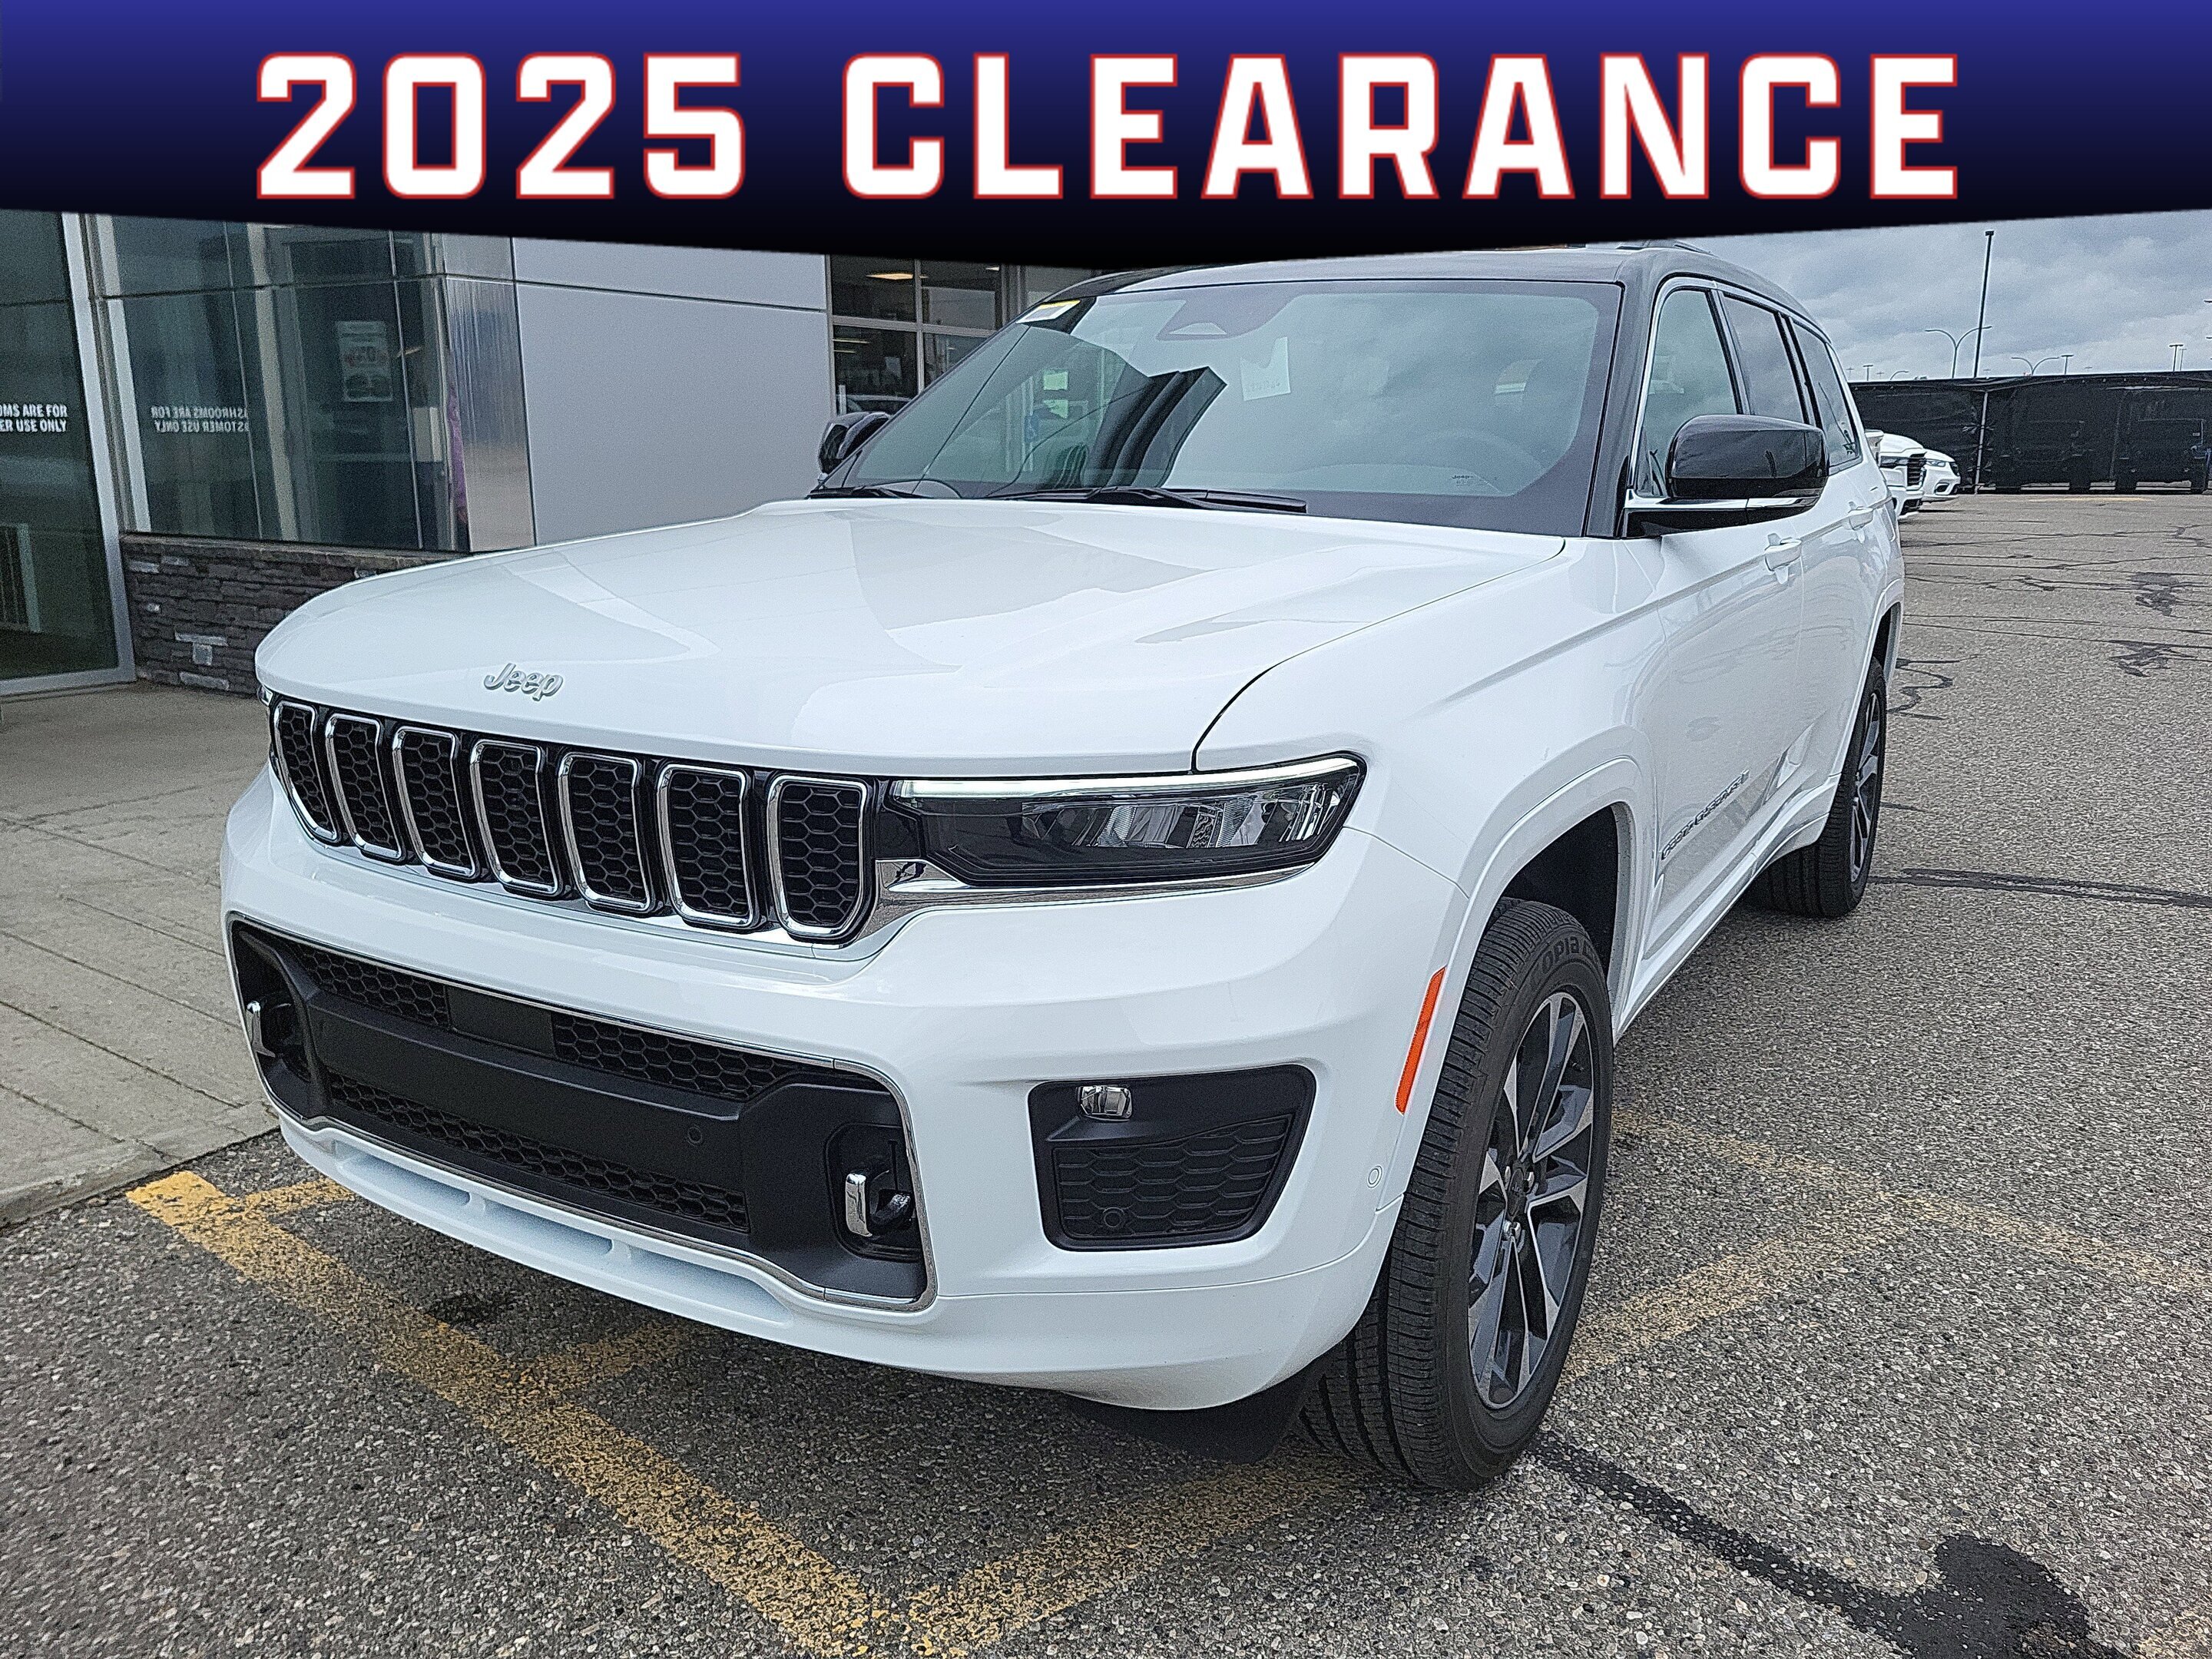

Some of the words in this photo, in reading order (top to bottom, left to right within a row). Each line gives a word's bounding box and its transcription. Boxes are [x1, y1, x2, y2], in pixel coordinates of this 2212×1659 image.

[22, 403, 44, 417] ARE
[46, 403, 68, 417] FOR
[15, 419, 38, 432] USE
[39, 418, 67, 432] ONLY
[483, 662, 564, 702] Jeep
